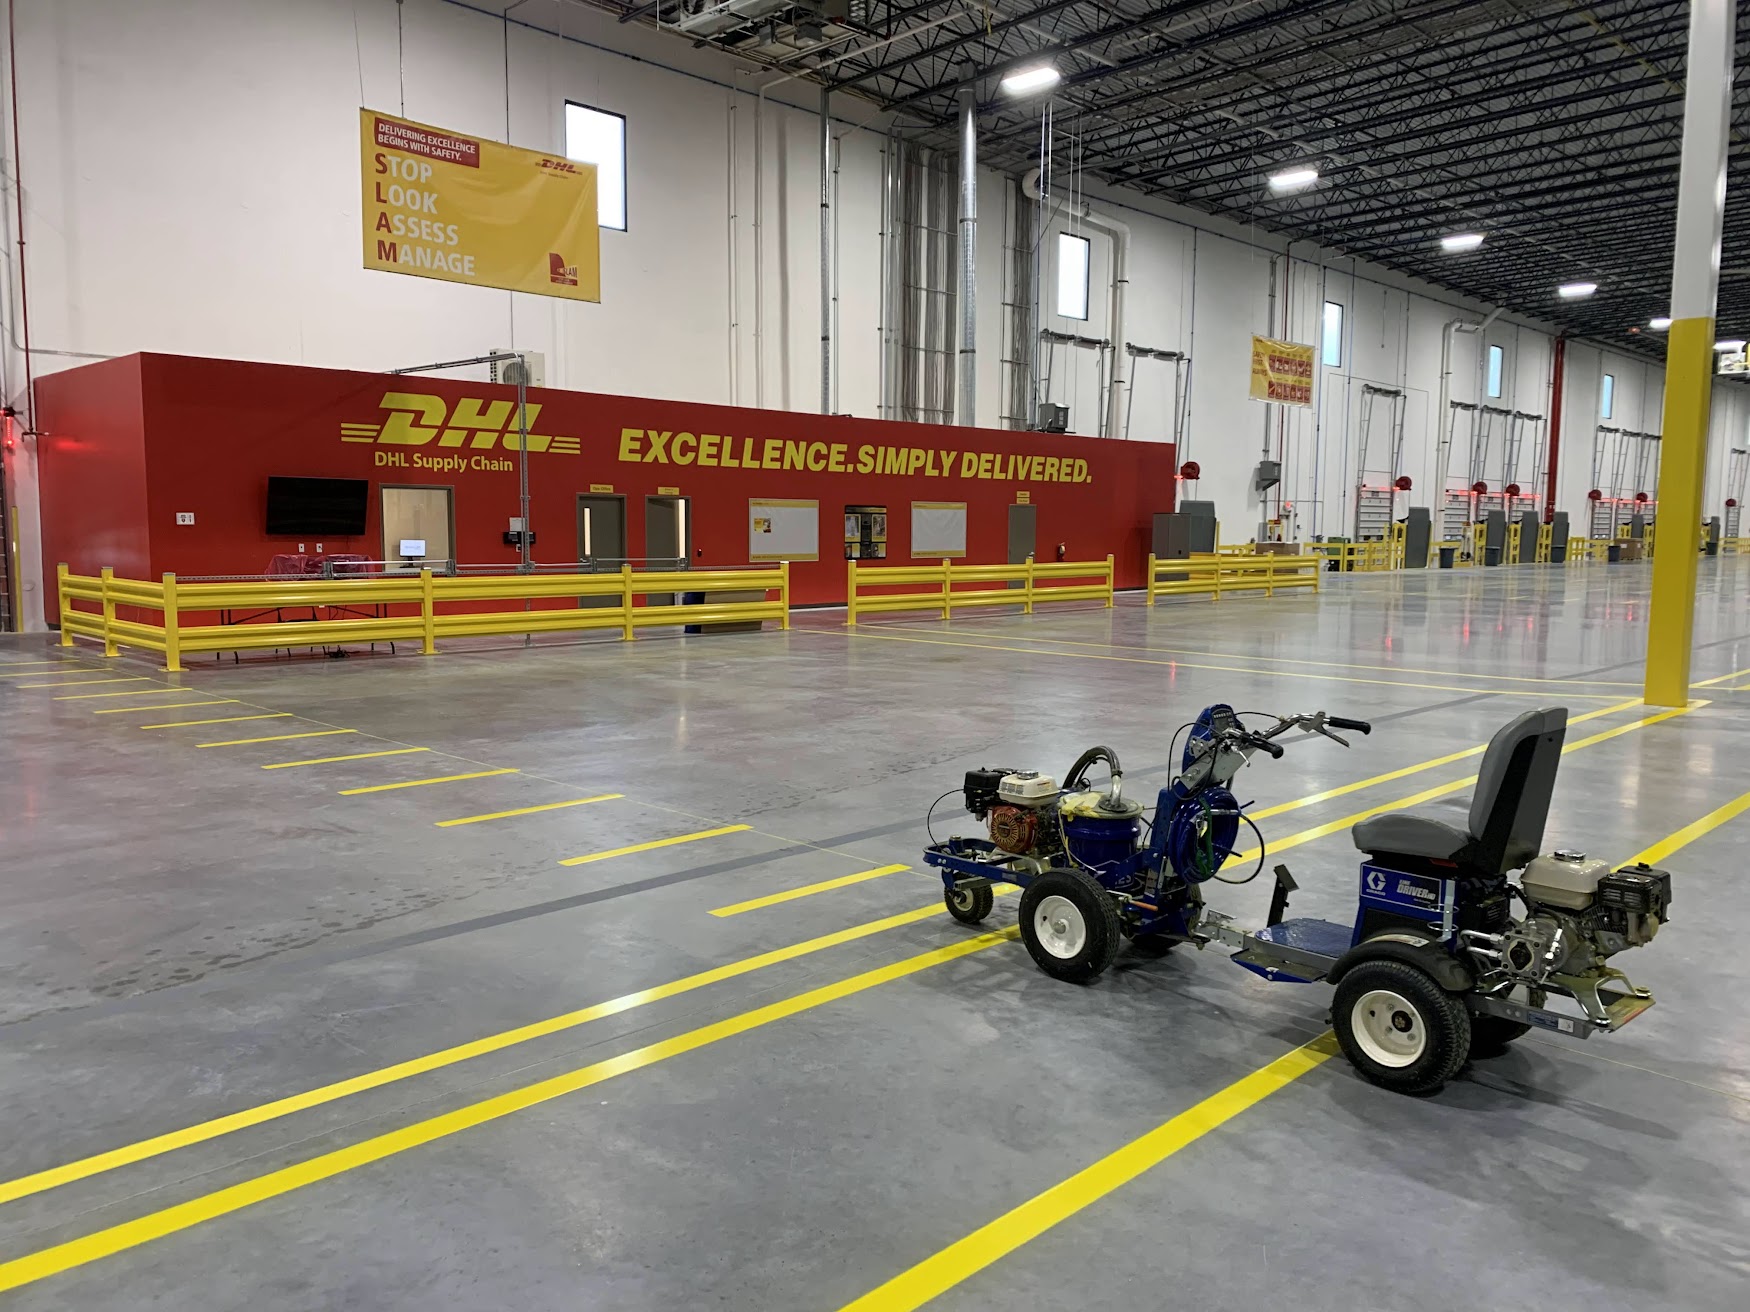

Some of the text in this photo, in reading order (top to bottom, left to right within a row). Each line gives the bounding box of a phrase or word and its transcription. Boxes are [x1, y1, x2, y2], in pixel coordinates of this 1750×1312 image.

[378, 122, 476, 154] DELIVERING EXCELLENCE
[378, 134, 462, 161] BEGINS WITH SAFETY.
[375, 152, 433, 183] STOP
[541, 158, 575, 174] DHL
[375, 181, 438, 215] LOOK
[375, 211, 459, 246] ASSESS
[377, 239, 476, 277] MANAGE
[377, 391, 553, 453] DHL
[374, 451, 513, 473] DHL Supply Chain
[960, 451, 1093, 484] DELIVERED.
